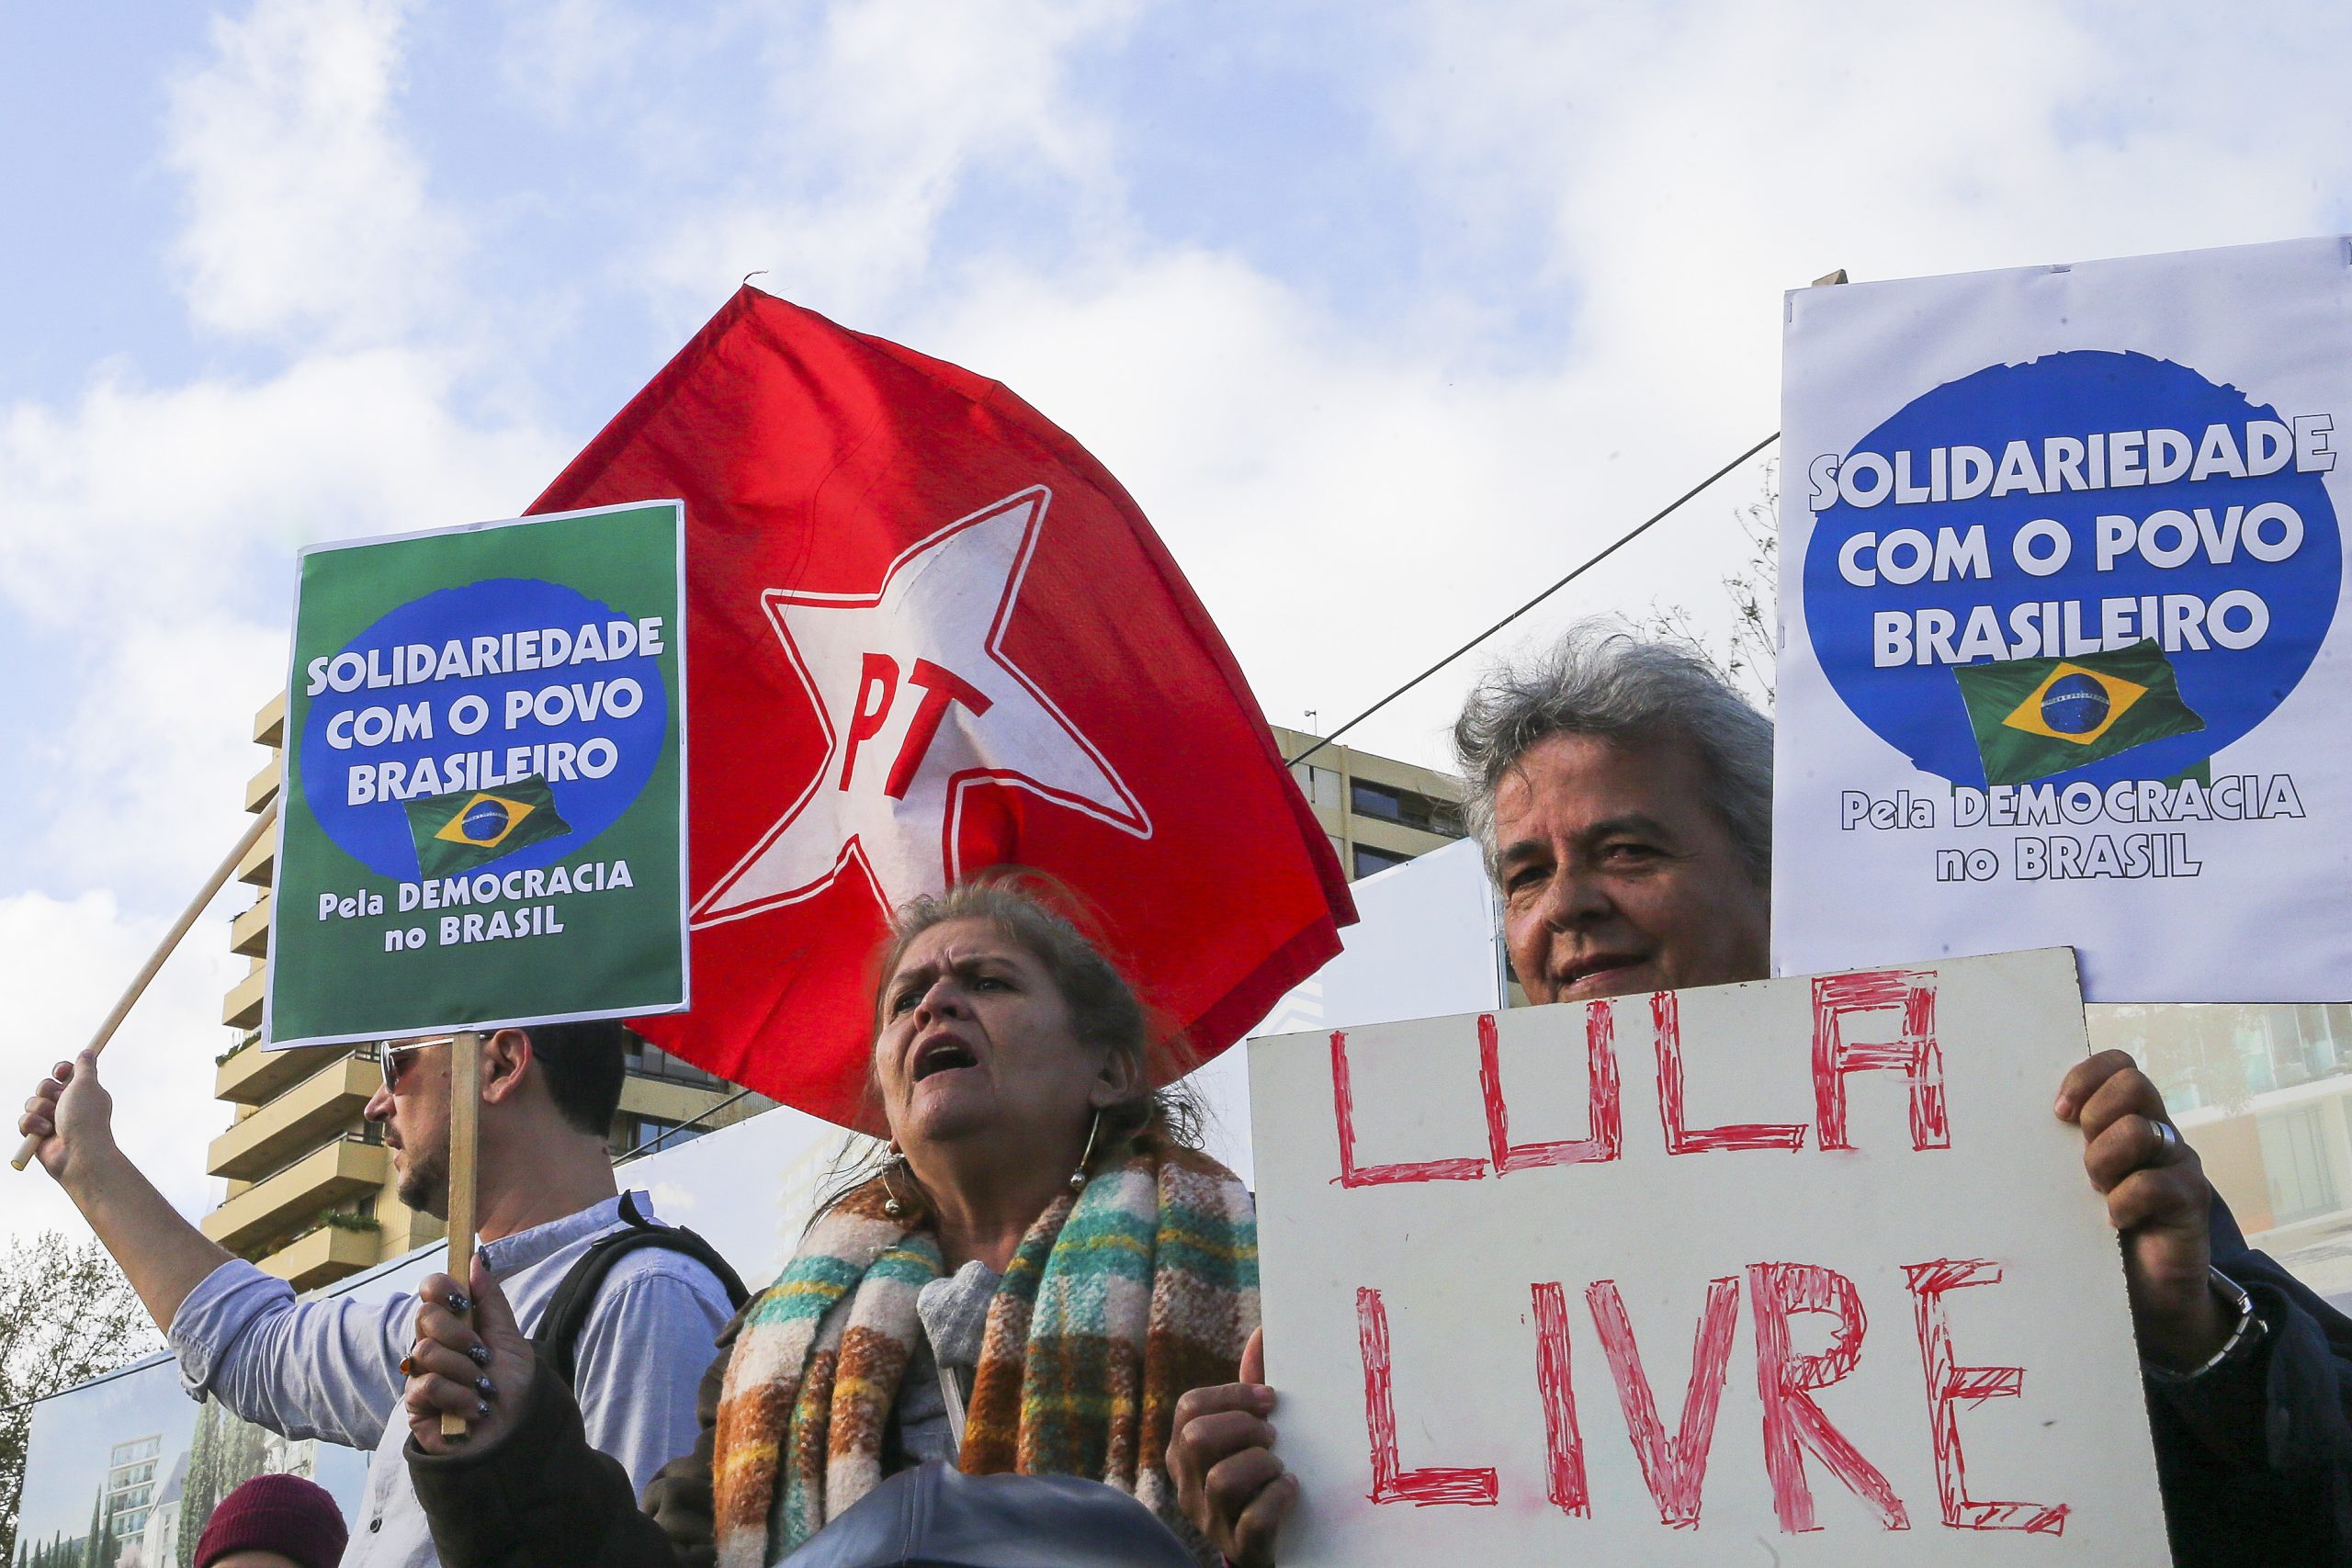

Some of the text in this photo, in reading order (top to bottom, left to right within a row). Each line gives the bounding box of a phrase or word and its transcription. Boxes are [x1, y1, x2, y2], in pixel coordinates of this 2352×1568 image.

[1809, 413, 2338, 513] SOLIDARIEDADE
[1838, 502, 2304, 587] COM O POVO
[306, 615, 665, 696] SOLIDARIEDADE
[1873, 590, 2269, 669] BRASILEIRO
[325, 677, 643, 750] COM O POVO
[839, 652, 994, 800] PT
[347, 737, 618, 807] BRASILEIRO
[1841, 774, 2306, 831] Pela DEMOCRACIA
[318, 860, 634, 921] Pela DEMOCRACIA
[1936, 834, 2202, 882] no BRASIL
[384, 905, 564, 953] no BRASIL
[1330, 970, 1951, 1188] LULA
[1354, 1258, 2073, 1535] LIVRE
